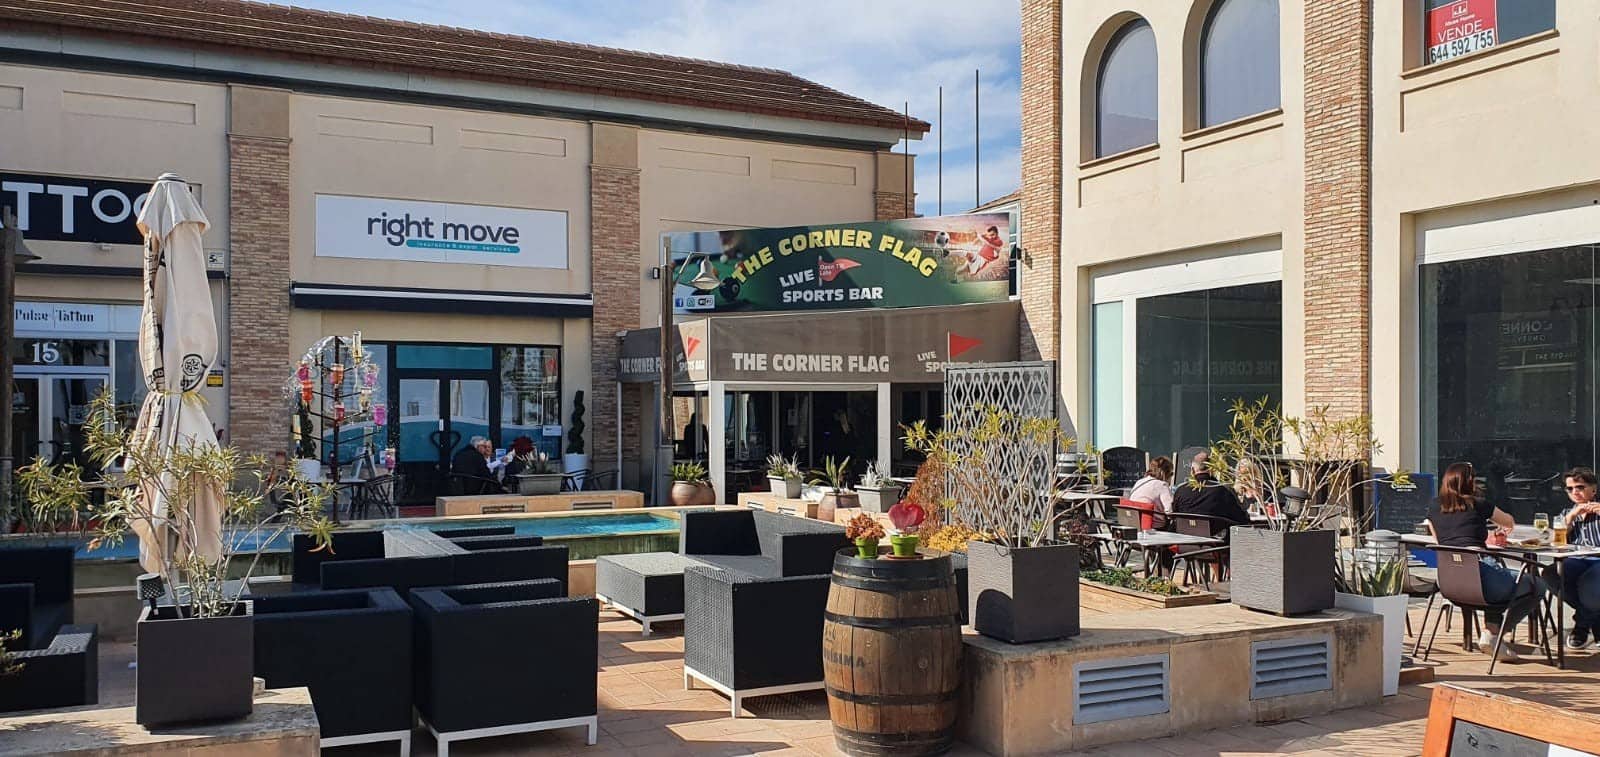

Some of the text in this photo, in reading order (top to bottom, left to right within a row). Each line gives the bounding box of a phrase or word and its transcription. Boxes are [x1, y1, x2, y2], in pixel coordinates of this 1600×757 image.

[1438, 19, 1482, 42] VENDE
[1430, 30, 1493, 64] 644 592 755
[0, 181, 147, 234] TTO
[367, 212, 519, 246] right move
[731, 229, 938, 284] THE CORNER FLAG
[779, 269, 815, 288] LIVE
[782, 287, 884, 303] SPORTS BAR
[15, 308, 49, 321] Pulse
[31, 341, 60, 363] 15
[732, 352, 889, 373] THE CORNER FLAG
[917, 351, 937, 362] LIVE
